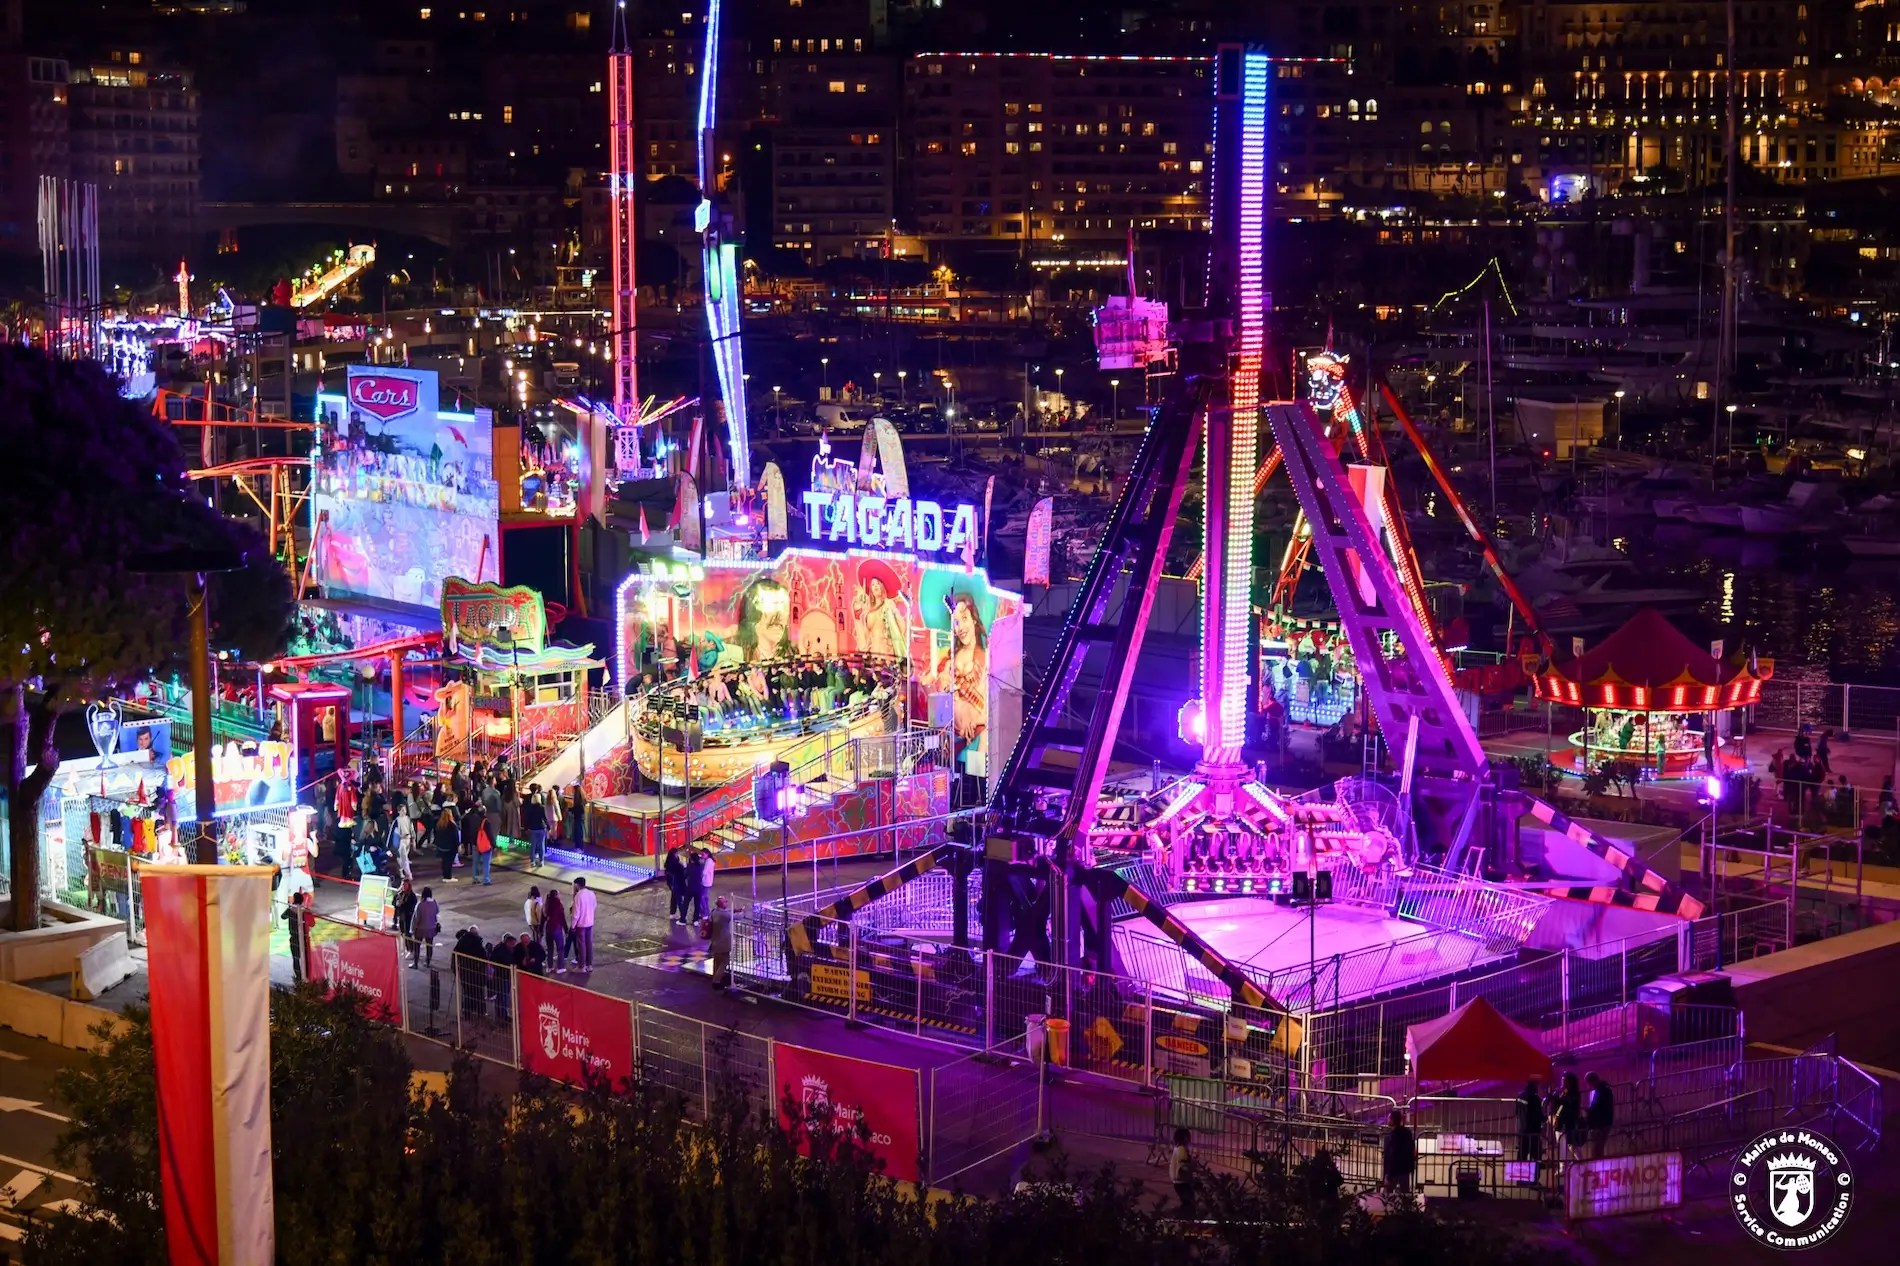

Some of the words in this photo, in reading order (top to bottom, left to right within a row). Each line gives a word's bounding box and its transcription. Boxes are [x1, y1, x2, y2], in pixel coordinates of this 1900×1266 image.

[355, 380, 411, 406] Cars
[803, 491, 977, 555] TAGADA
[450, 595, 531, 638] TAGADA
[341, 960, 364, 979] Mairie
[562, 1027, 590, 1047] Mairie
[1165, 1037, 1200, 1053] DANGER
[562, 1044, 573, 1059] de
